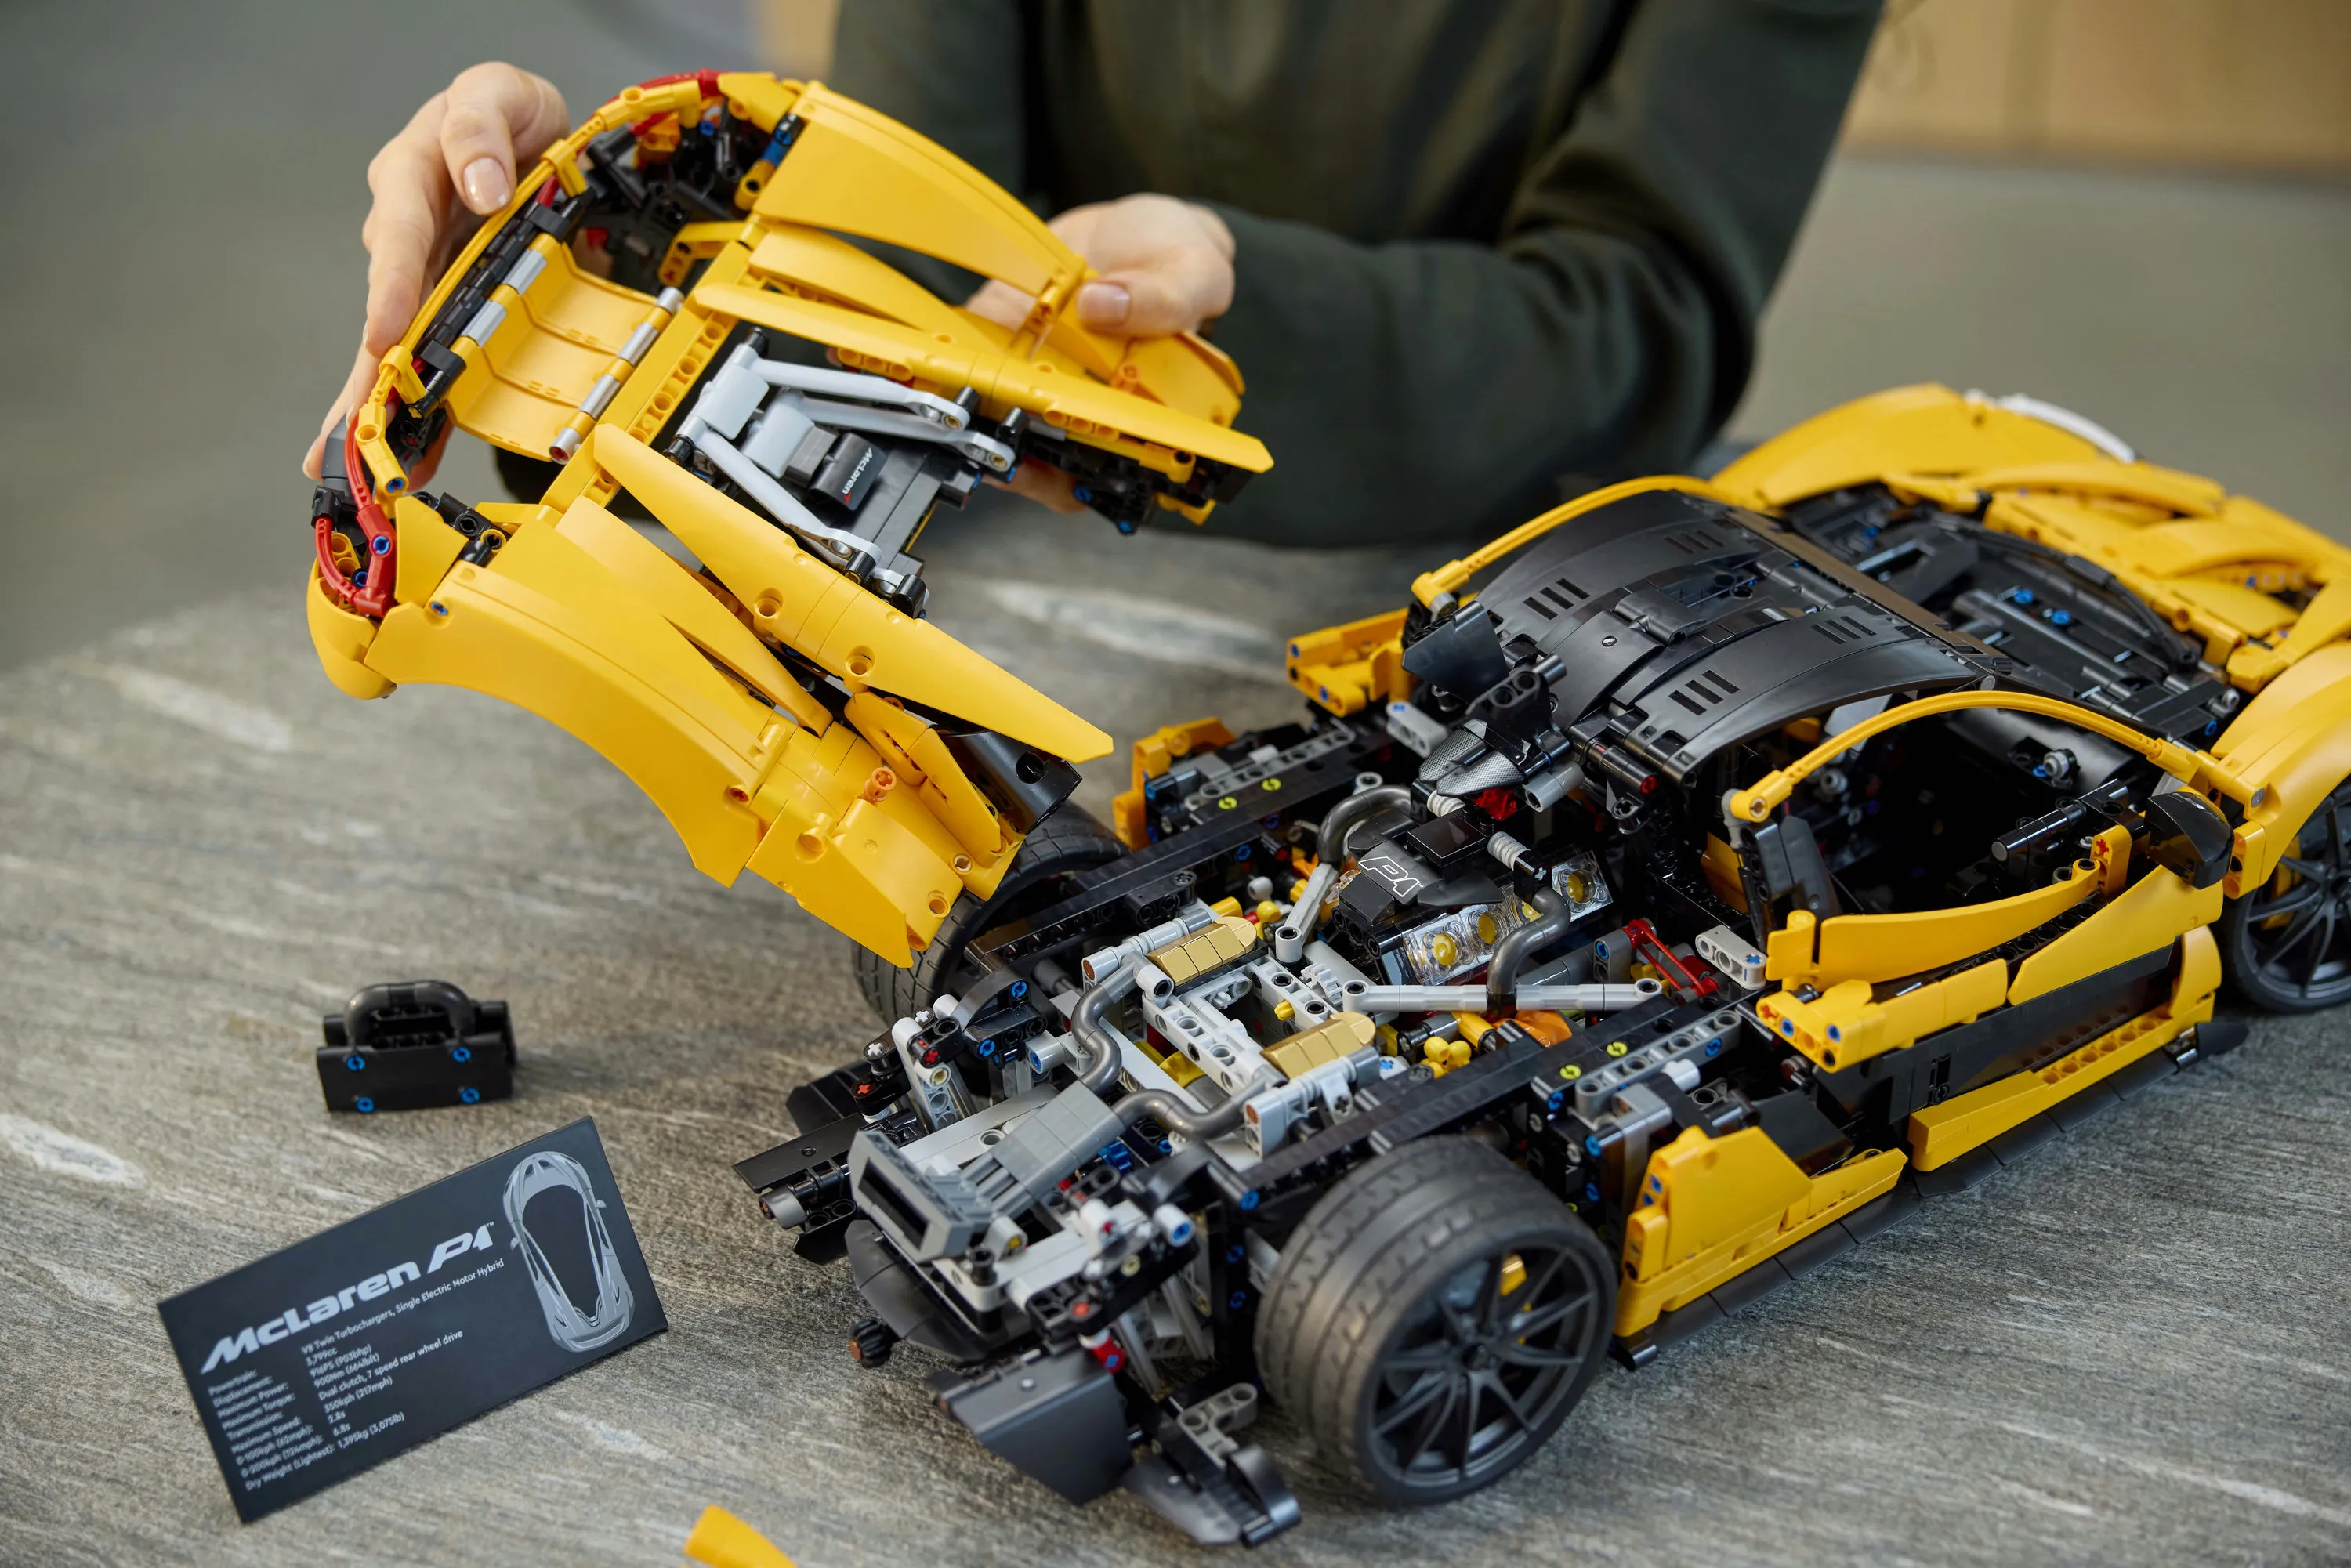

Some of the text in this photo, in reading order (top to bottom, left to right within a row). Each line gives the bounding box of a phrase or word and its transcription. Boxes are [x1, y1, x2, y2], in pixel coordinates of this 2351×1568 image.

[842, 447, 873, 494] McLaren
[201, 1261, 421, 1373] McLaren
[313, 1335, 335, 1349] Twin
[334, 1309, 396, 1340] Turbochargers,
[395, 1297, 421, 1313] Single
[421, 1283, 452, 1302] Electric
[452, 1272, 476, 1288] Motor
[476, 1258, 505, 1277] Hybrid
[317, 1331, 463, 1401] Dual clutch, 7 speed rear wheel drive
